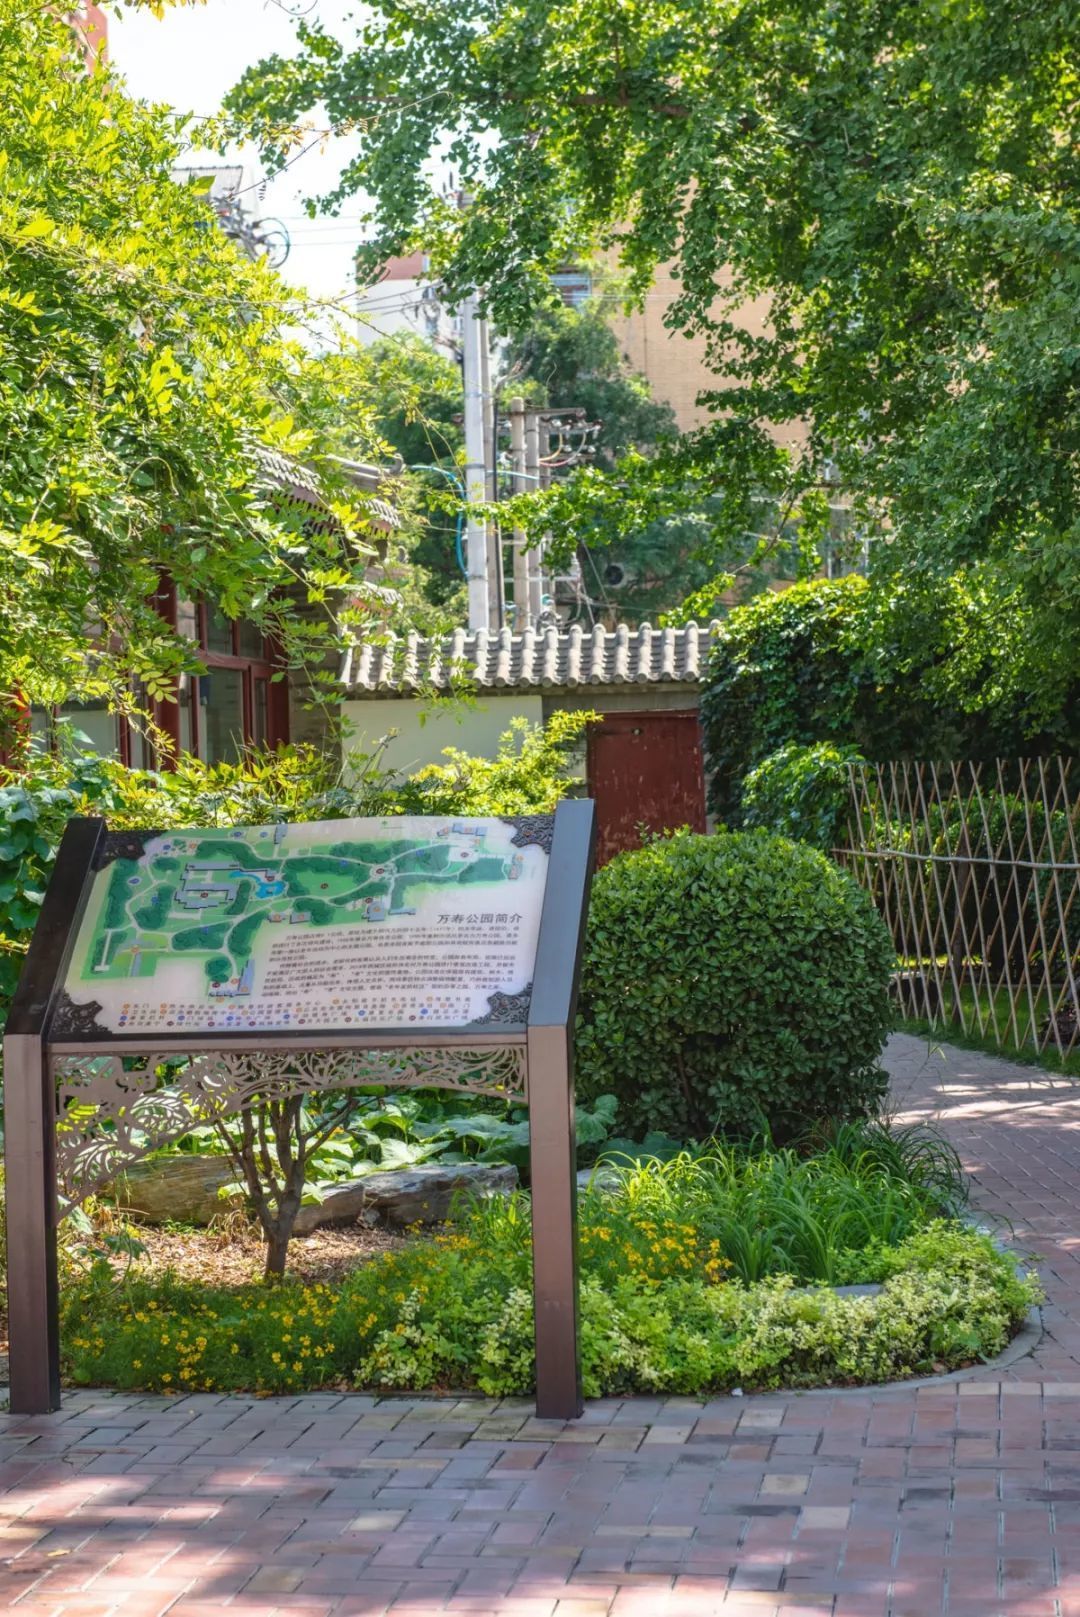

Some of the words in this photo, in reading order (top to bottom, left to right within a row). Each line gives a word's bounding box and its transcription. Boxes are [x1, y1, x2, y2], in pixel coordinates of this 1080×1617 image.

[437, 913, 523, 924] 万寿公园简介
